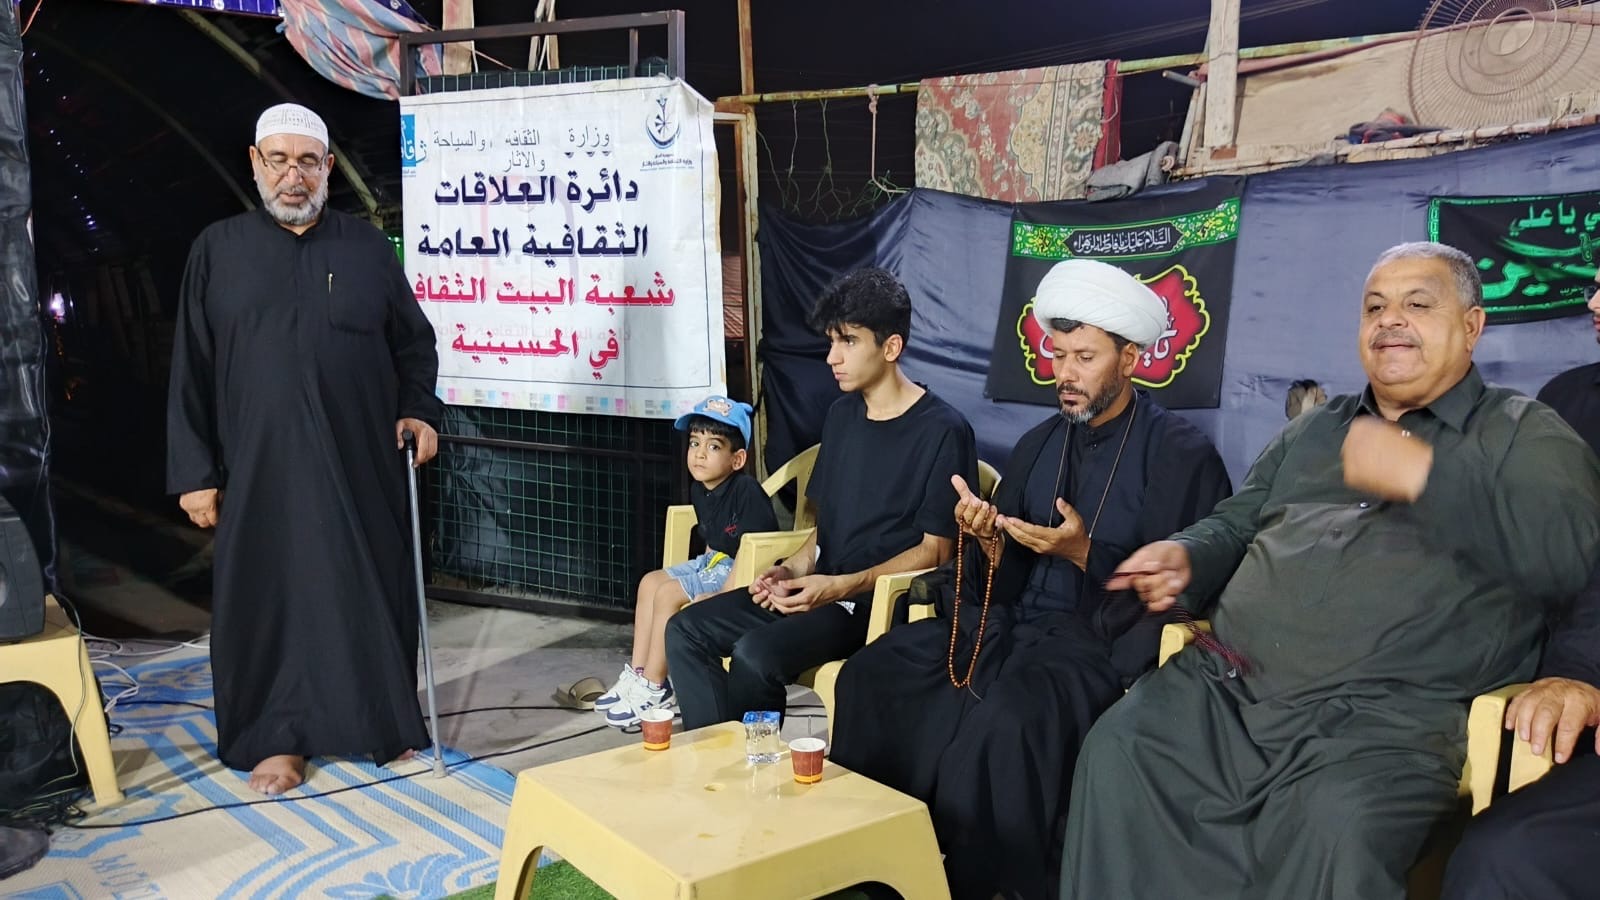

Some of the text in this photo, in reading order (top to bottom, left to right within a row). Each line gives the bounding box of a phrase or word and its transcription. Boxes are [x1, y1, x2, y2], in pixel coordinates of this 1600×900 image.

[569, 126, 610, 147] وزارة
[434, 168, 639, 213] دائرة العلاقات
[417, 222, 648, 267] الثقافية العامة
[414, 271, 676, 315] شعبة البيت الثقاف
[451, 323, 620, 380] في الحسينية
